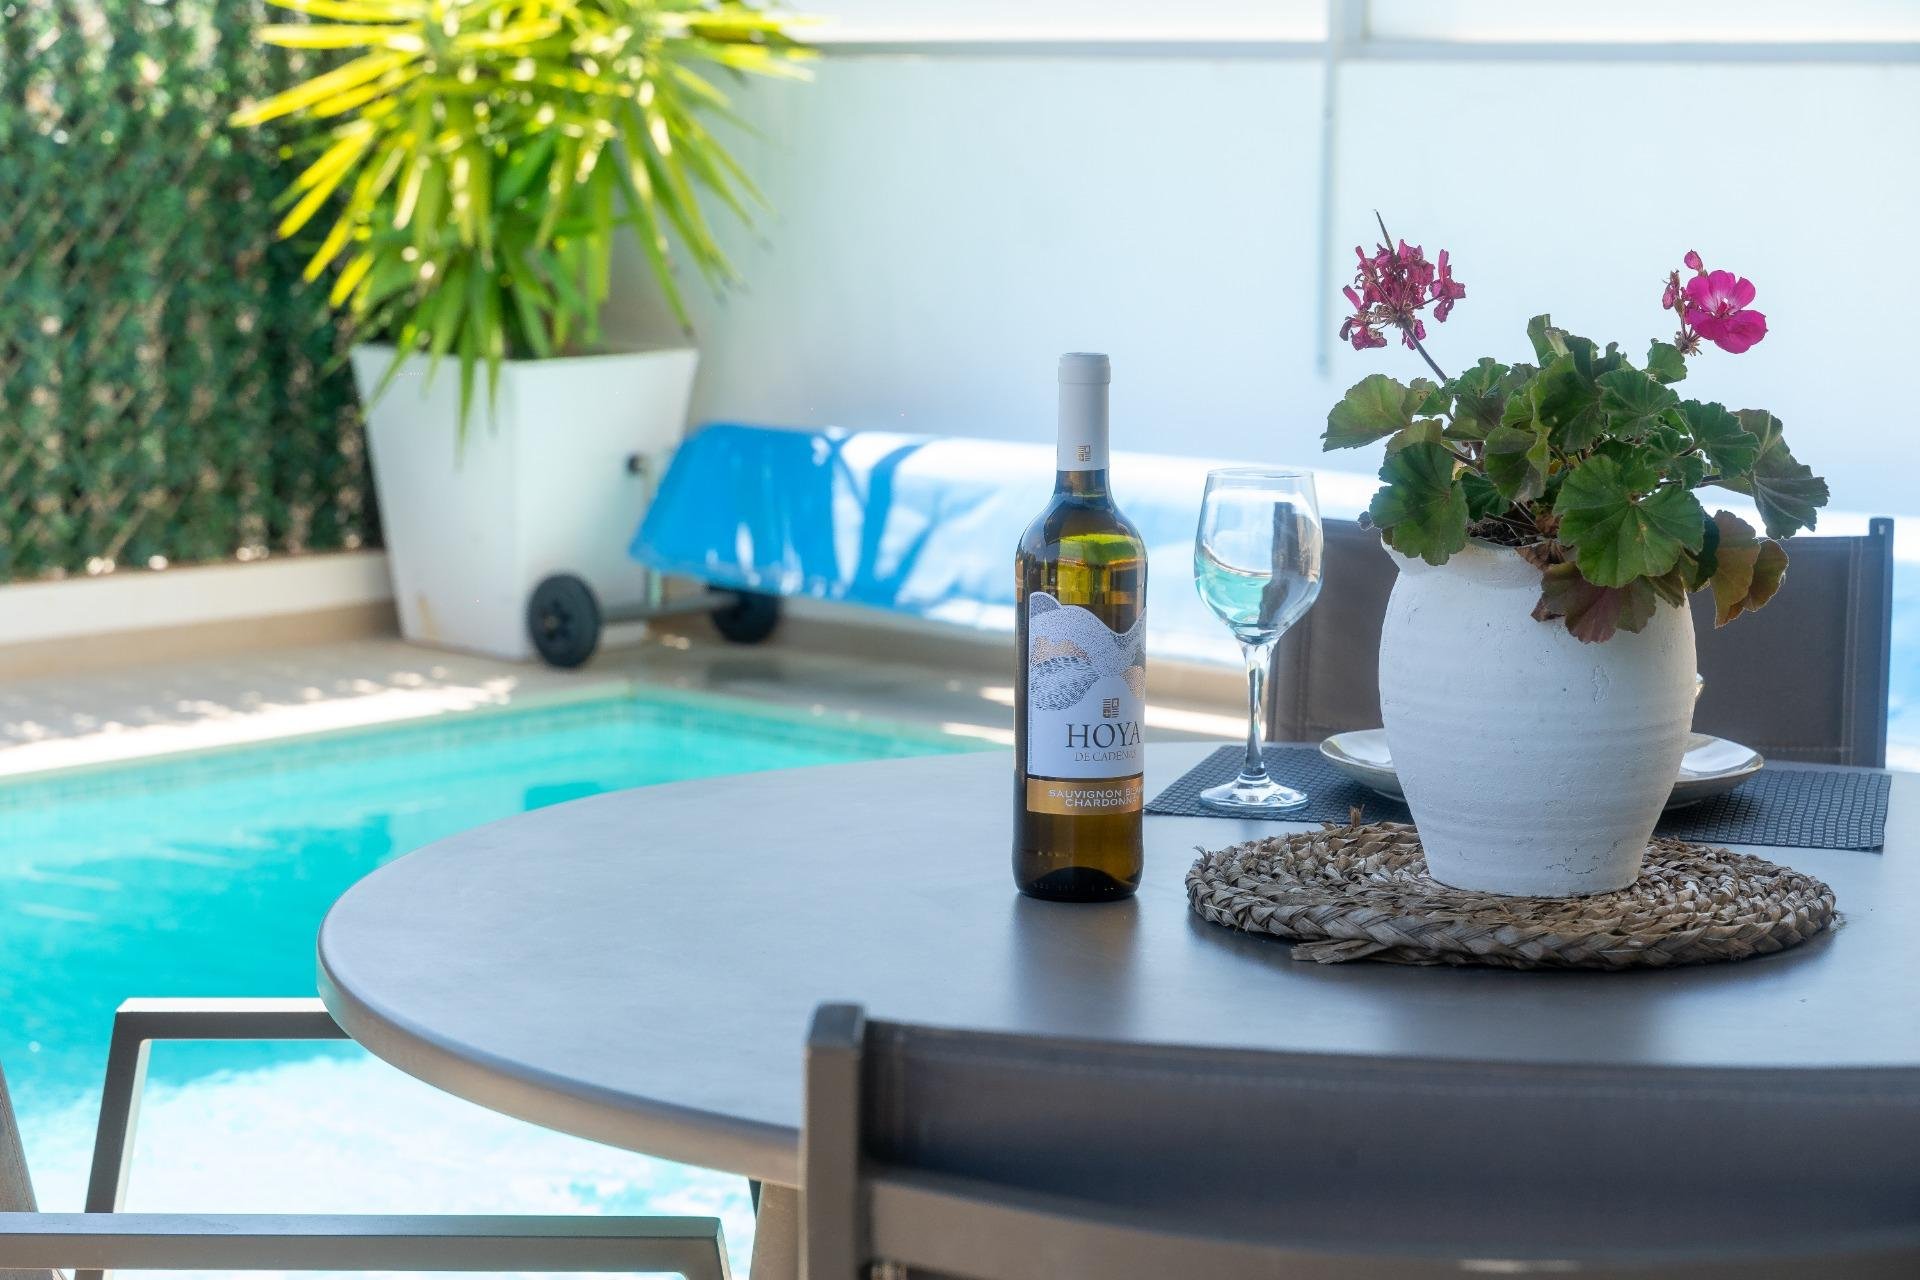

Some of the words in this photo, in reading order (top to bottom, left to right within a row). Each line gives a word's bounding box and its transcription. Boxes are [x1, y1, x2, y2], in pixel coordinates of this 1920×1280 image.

[1065, 721, 1141, 749] HOYA
[1074, 752, 1090, 762] DE
[1048, 789, 1122, 799] SAUVIGNON
